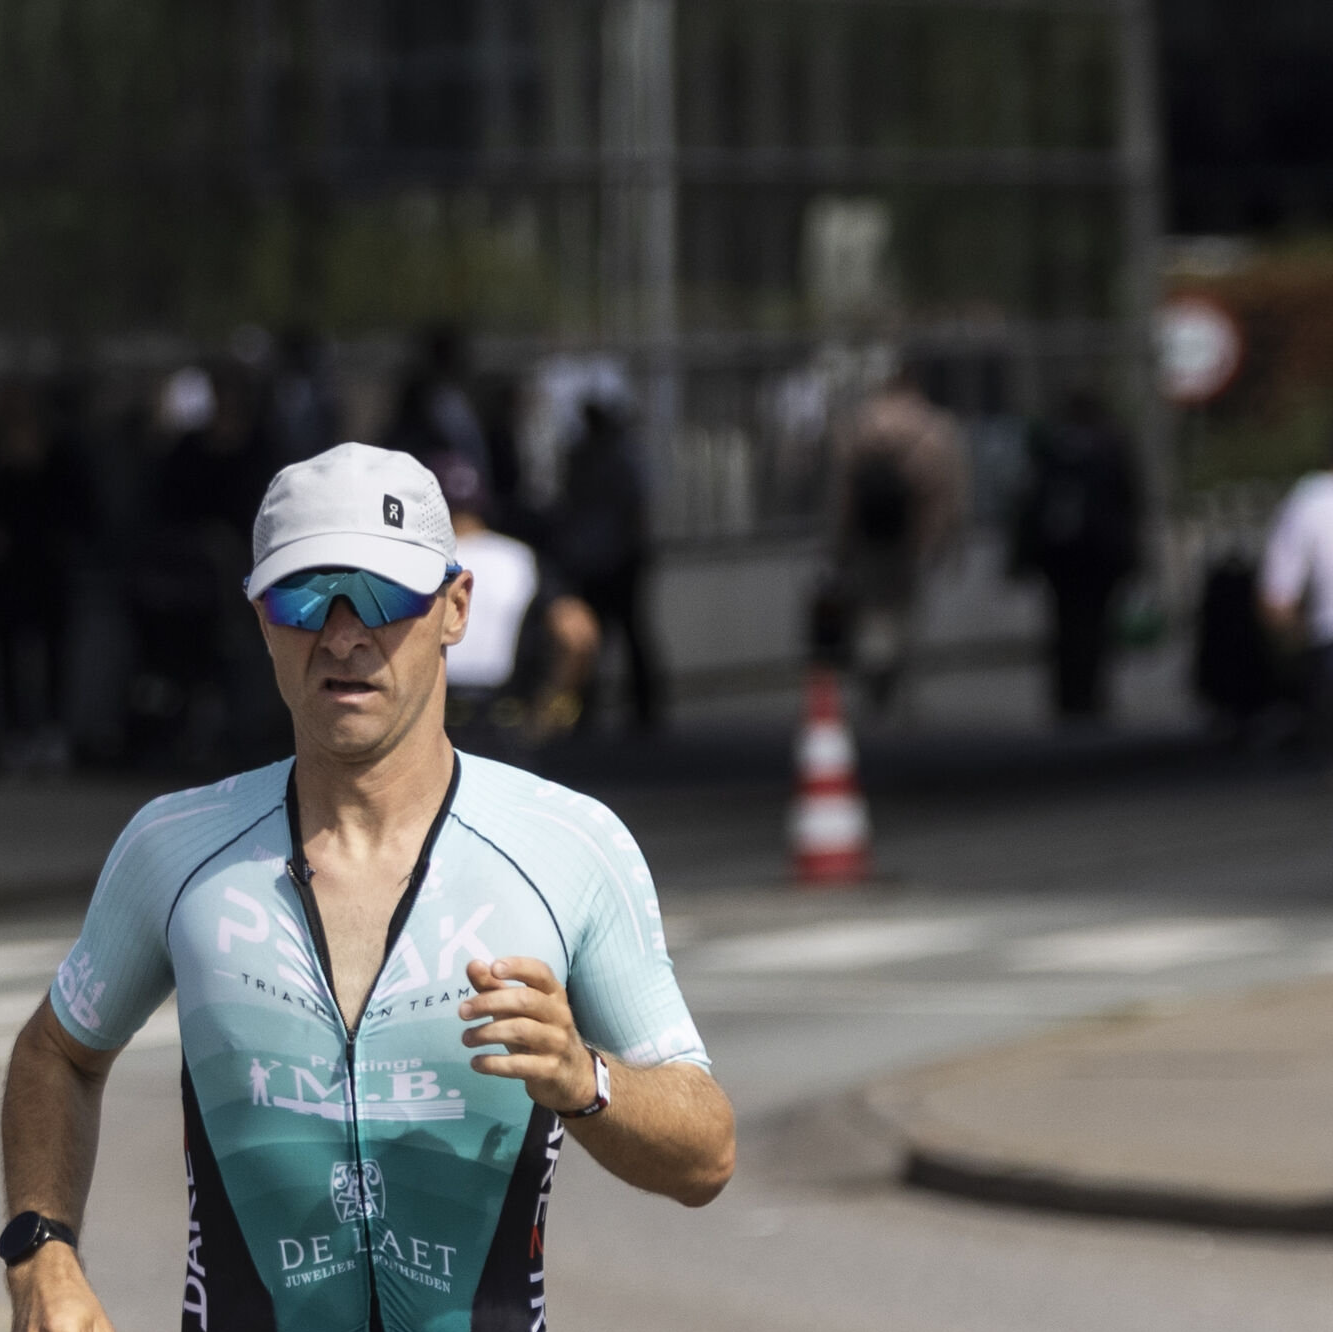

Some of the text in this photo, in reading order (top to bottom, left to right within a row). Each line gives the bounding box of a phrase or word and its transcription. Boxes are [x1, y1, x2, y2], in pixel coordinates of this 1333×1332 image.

[241, 972, 471, 1022] TRIATHON TEAM
[278, 1227, 457, 1278] DE LAET
[285, 1260, 357, 1289] JUWELIER
